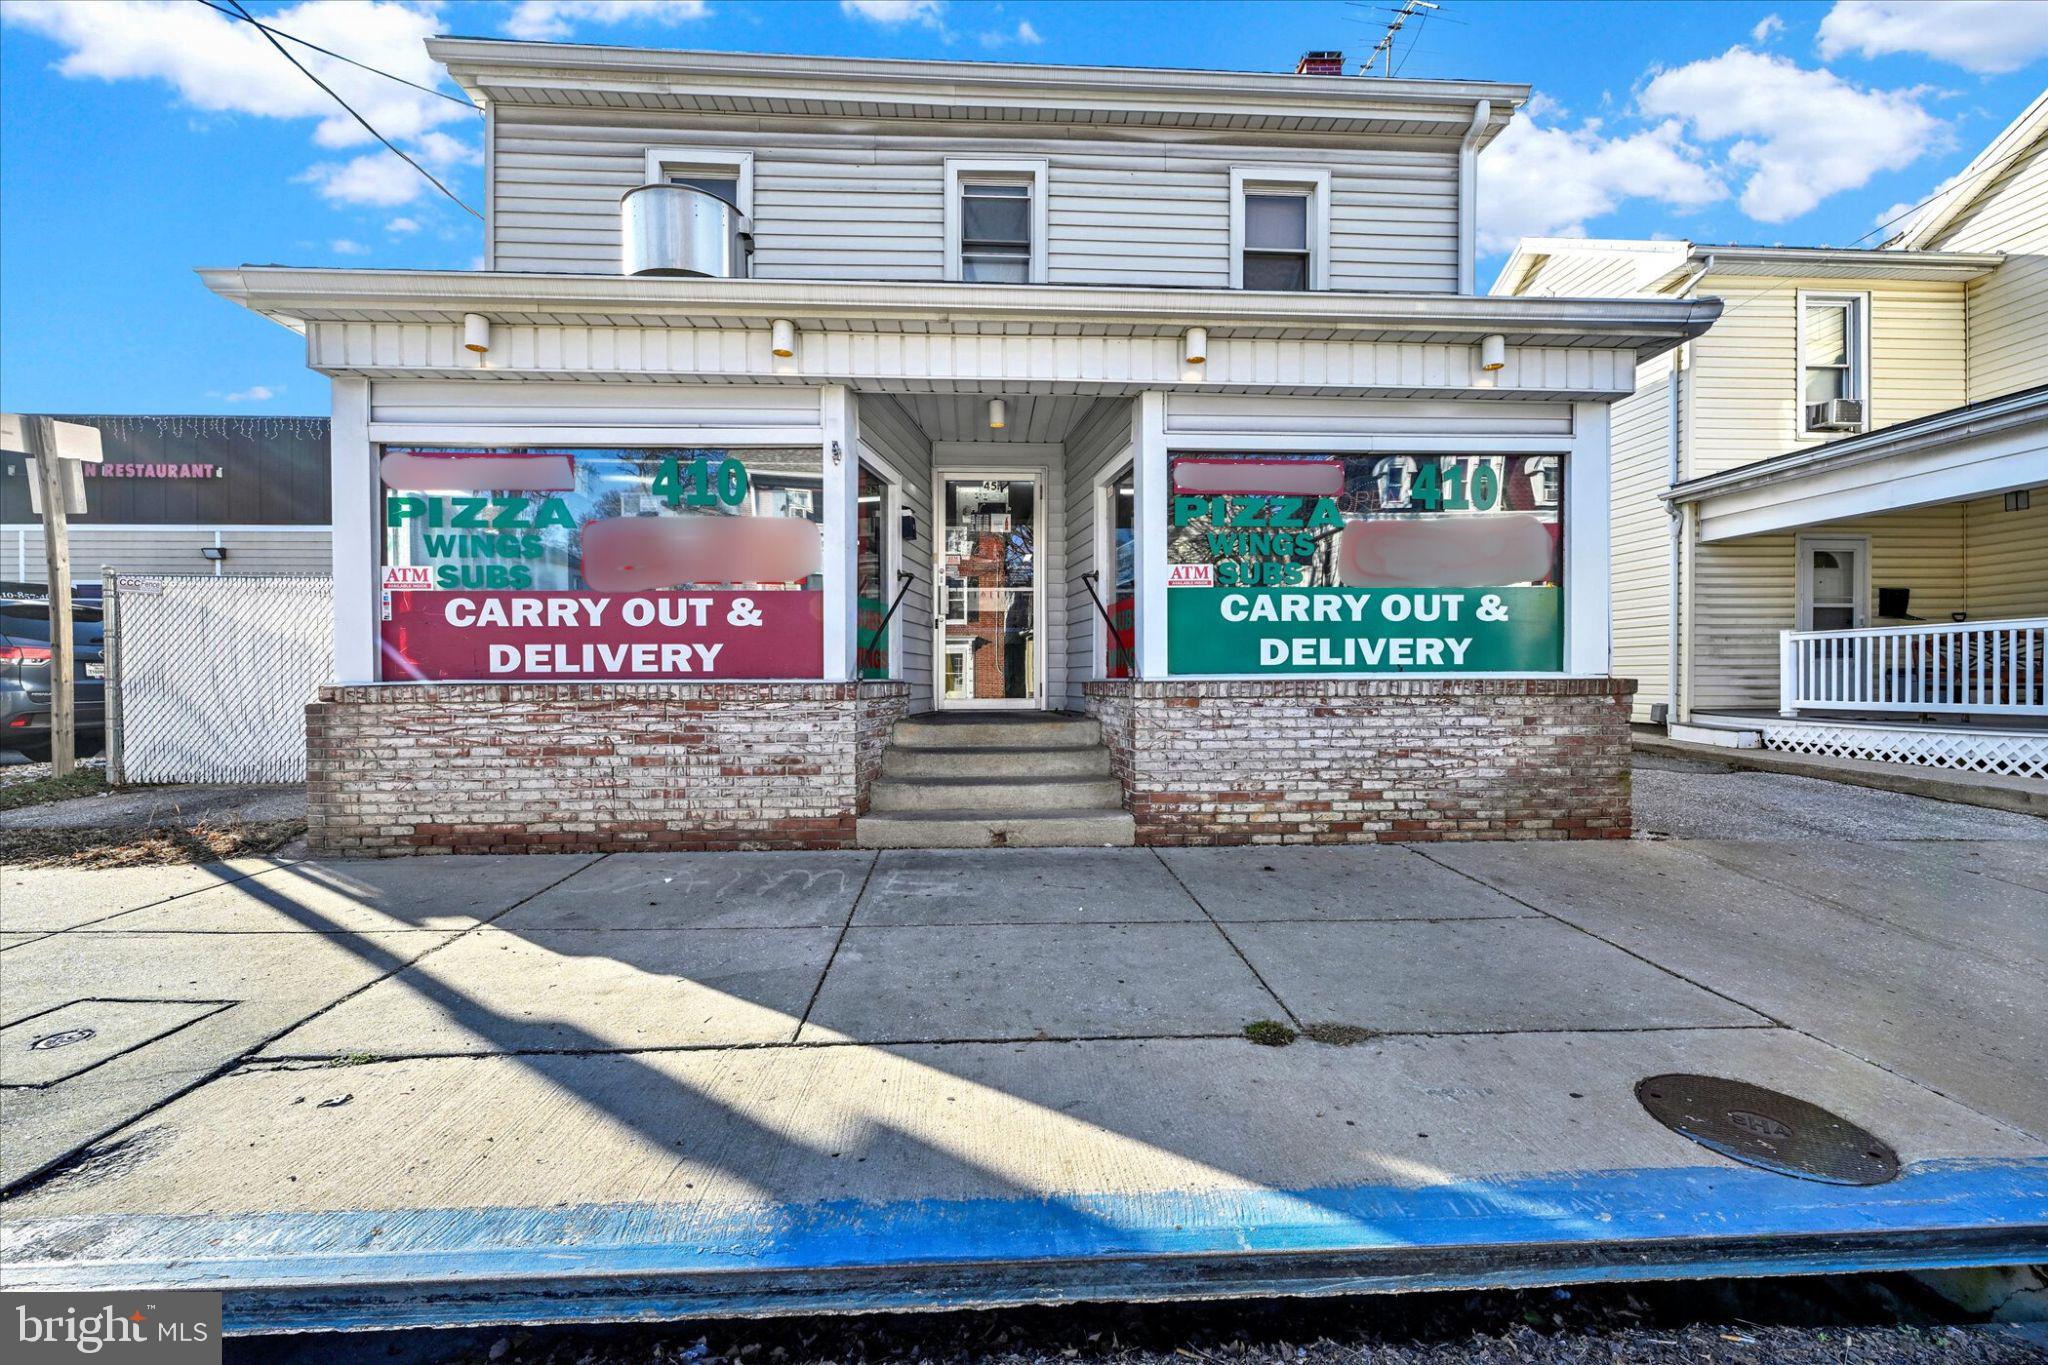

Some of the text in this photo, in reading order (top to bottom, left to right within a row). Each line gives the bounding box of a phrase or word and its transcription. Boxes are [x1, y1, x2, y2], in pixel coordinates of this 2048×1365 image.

[104, 463, 214, 478] RESTAURANT
[652, 456, 748, 506] 410
[1411, 464, 1498, 511] 410
[388, 497, 578, 528] PIZZA
[1175, 496, 1345, 528] PIZZA
[423, 534, 544, 559] WINGS
[1207, 533, 1316, 557] WINGS
[386, 568, 429, 582] ATM
[437, 564, 532, 590] SUBS
[1170, 566, 1209, 580] ATM
[1218, 561, 1304, 586] SUBS
[444, 598, 763, 627] CARRY OUT &
[1220, 594, 1509, 621] CARRY OUT &
[490, 643, 724, 672] DELIVERY
[1260, 638, 1473, 665] DELIVERY
